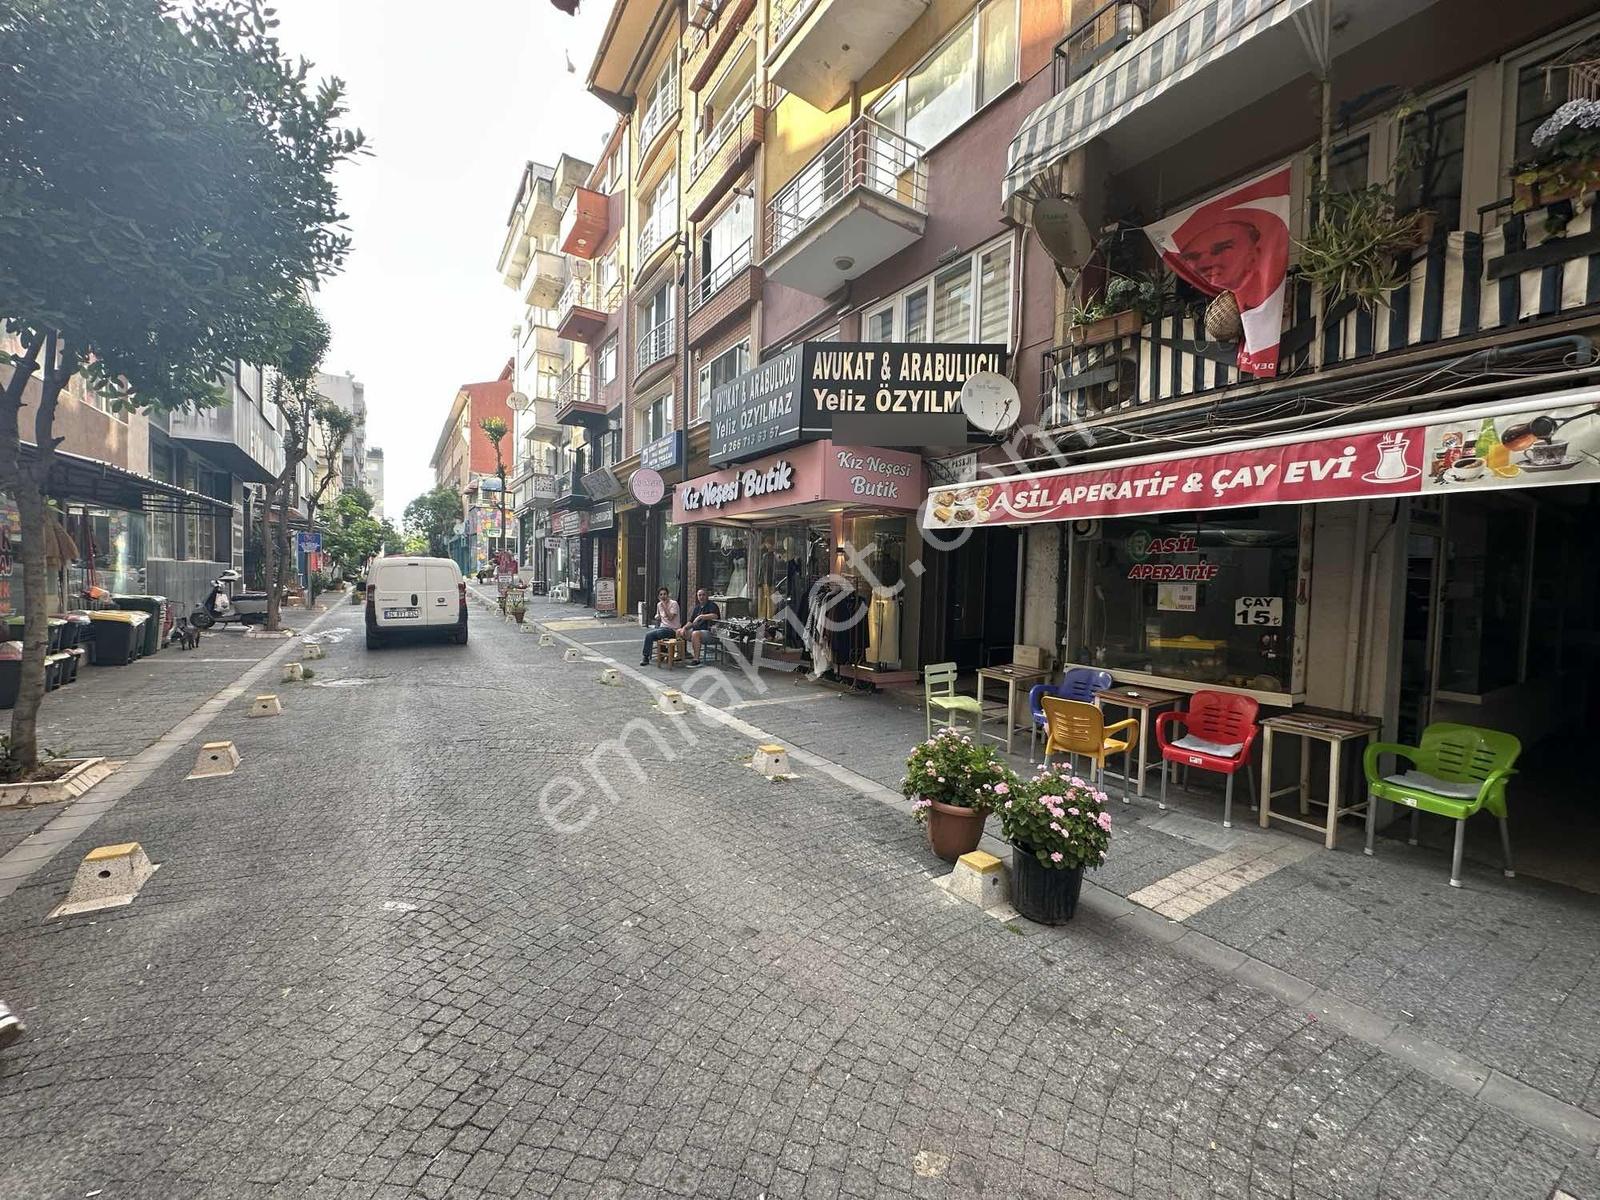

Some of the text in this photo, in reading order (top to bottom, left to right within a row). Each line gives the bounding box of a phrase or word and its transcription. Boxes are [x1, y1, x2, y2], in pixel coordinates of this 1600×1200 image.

[812, 351, 875, 380] AVUKAT
[881, 351, 891, 381] &
[715, 353, 797, 417] AVUKAT & ARABULUCU
[813, 383, 962, 413] Yeliz ÖZYILM
[716, 390, 793, 440] Yeliz ÖZYILMAZ
[837, 451, 863, 470] Kız
[867, 456, 912, 478] Neşesi
[682, 461, 792, 510] Kız Neşesi Butik
[850, 475, 899, 498] Butik
[989, 446, 1357, 517] ASİL APERATİF & ÇAY EVİ
[1145, 533, 1199, 554] ASİL
[1128, 560, 1220, 581] APERATİF
[1242, 597, 1274, 608] ÇAY
